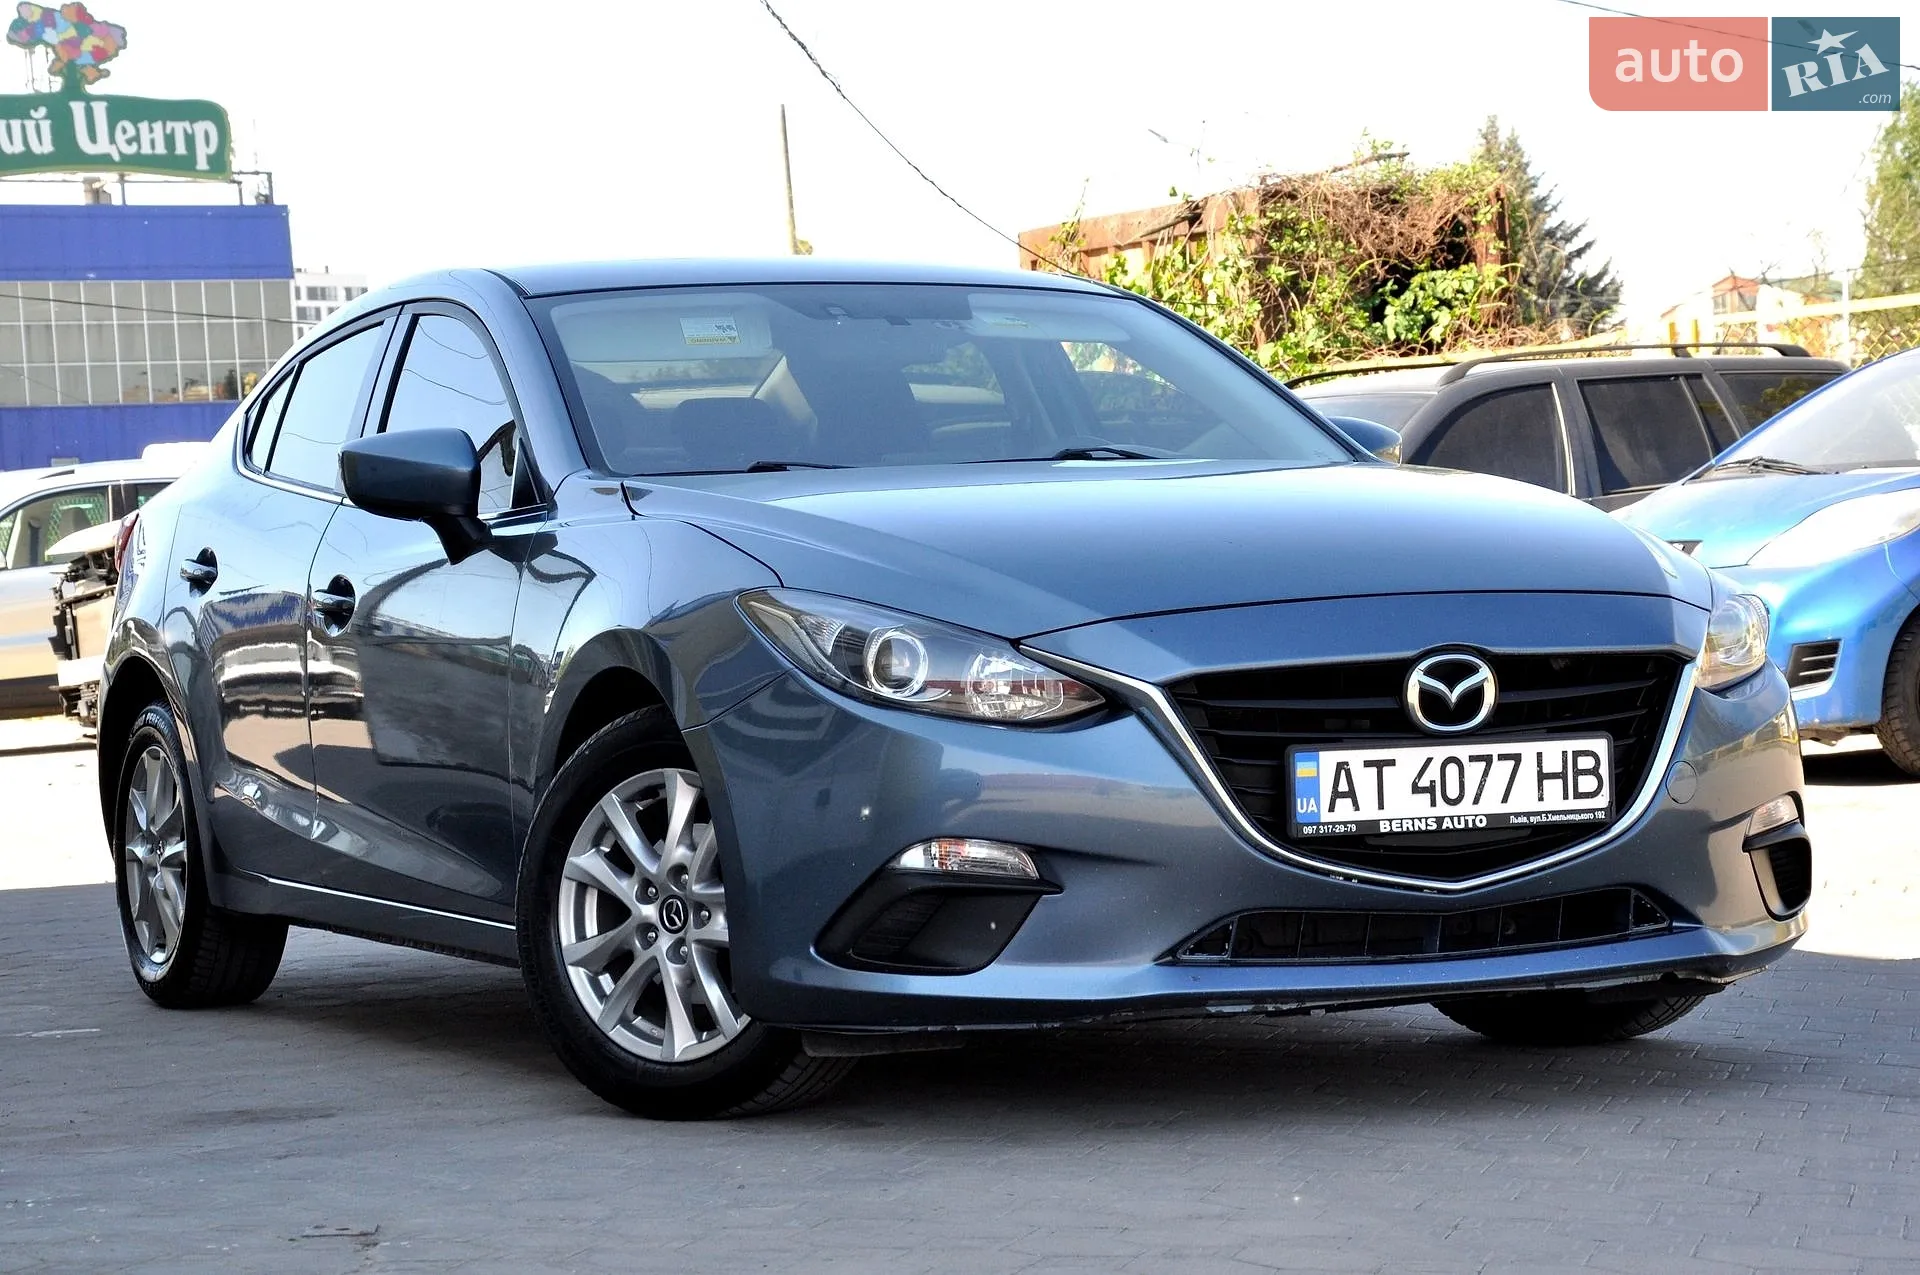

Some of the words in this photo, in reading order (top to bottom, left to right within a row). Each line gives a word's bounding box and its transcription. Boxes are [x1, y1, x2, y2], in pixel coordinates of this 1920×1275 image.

[68, 100, 219, 171] Центр
[1327, 758, 1396, 813] AT
[1410, 752, 1522, 808] 4077
[1535, 749, 1604, 802] HB
[1297, 799, 1318, 814] UA
[1594, 810, 1606, 820] 192
[1302, 825, 1317, 834] 097
[1318, 823, 1356, 834] 317-29-79
[1379, 816, 1437, 833] BERNS
[1441, 814, 1488, 830] AUTO
